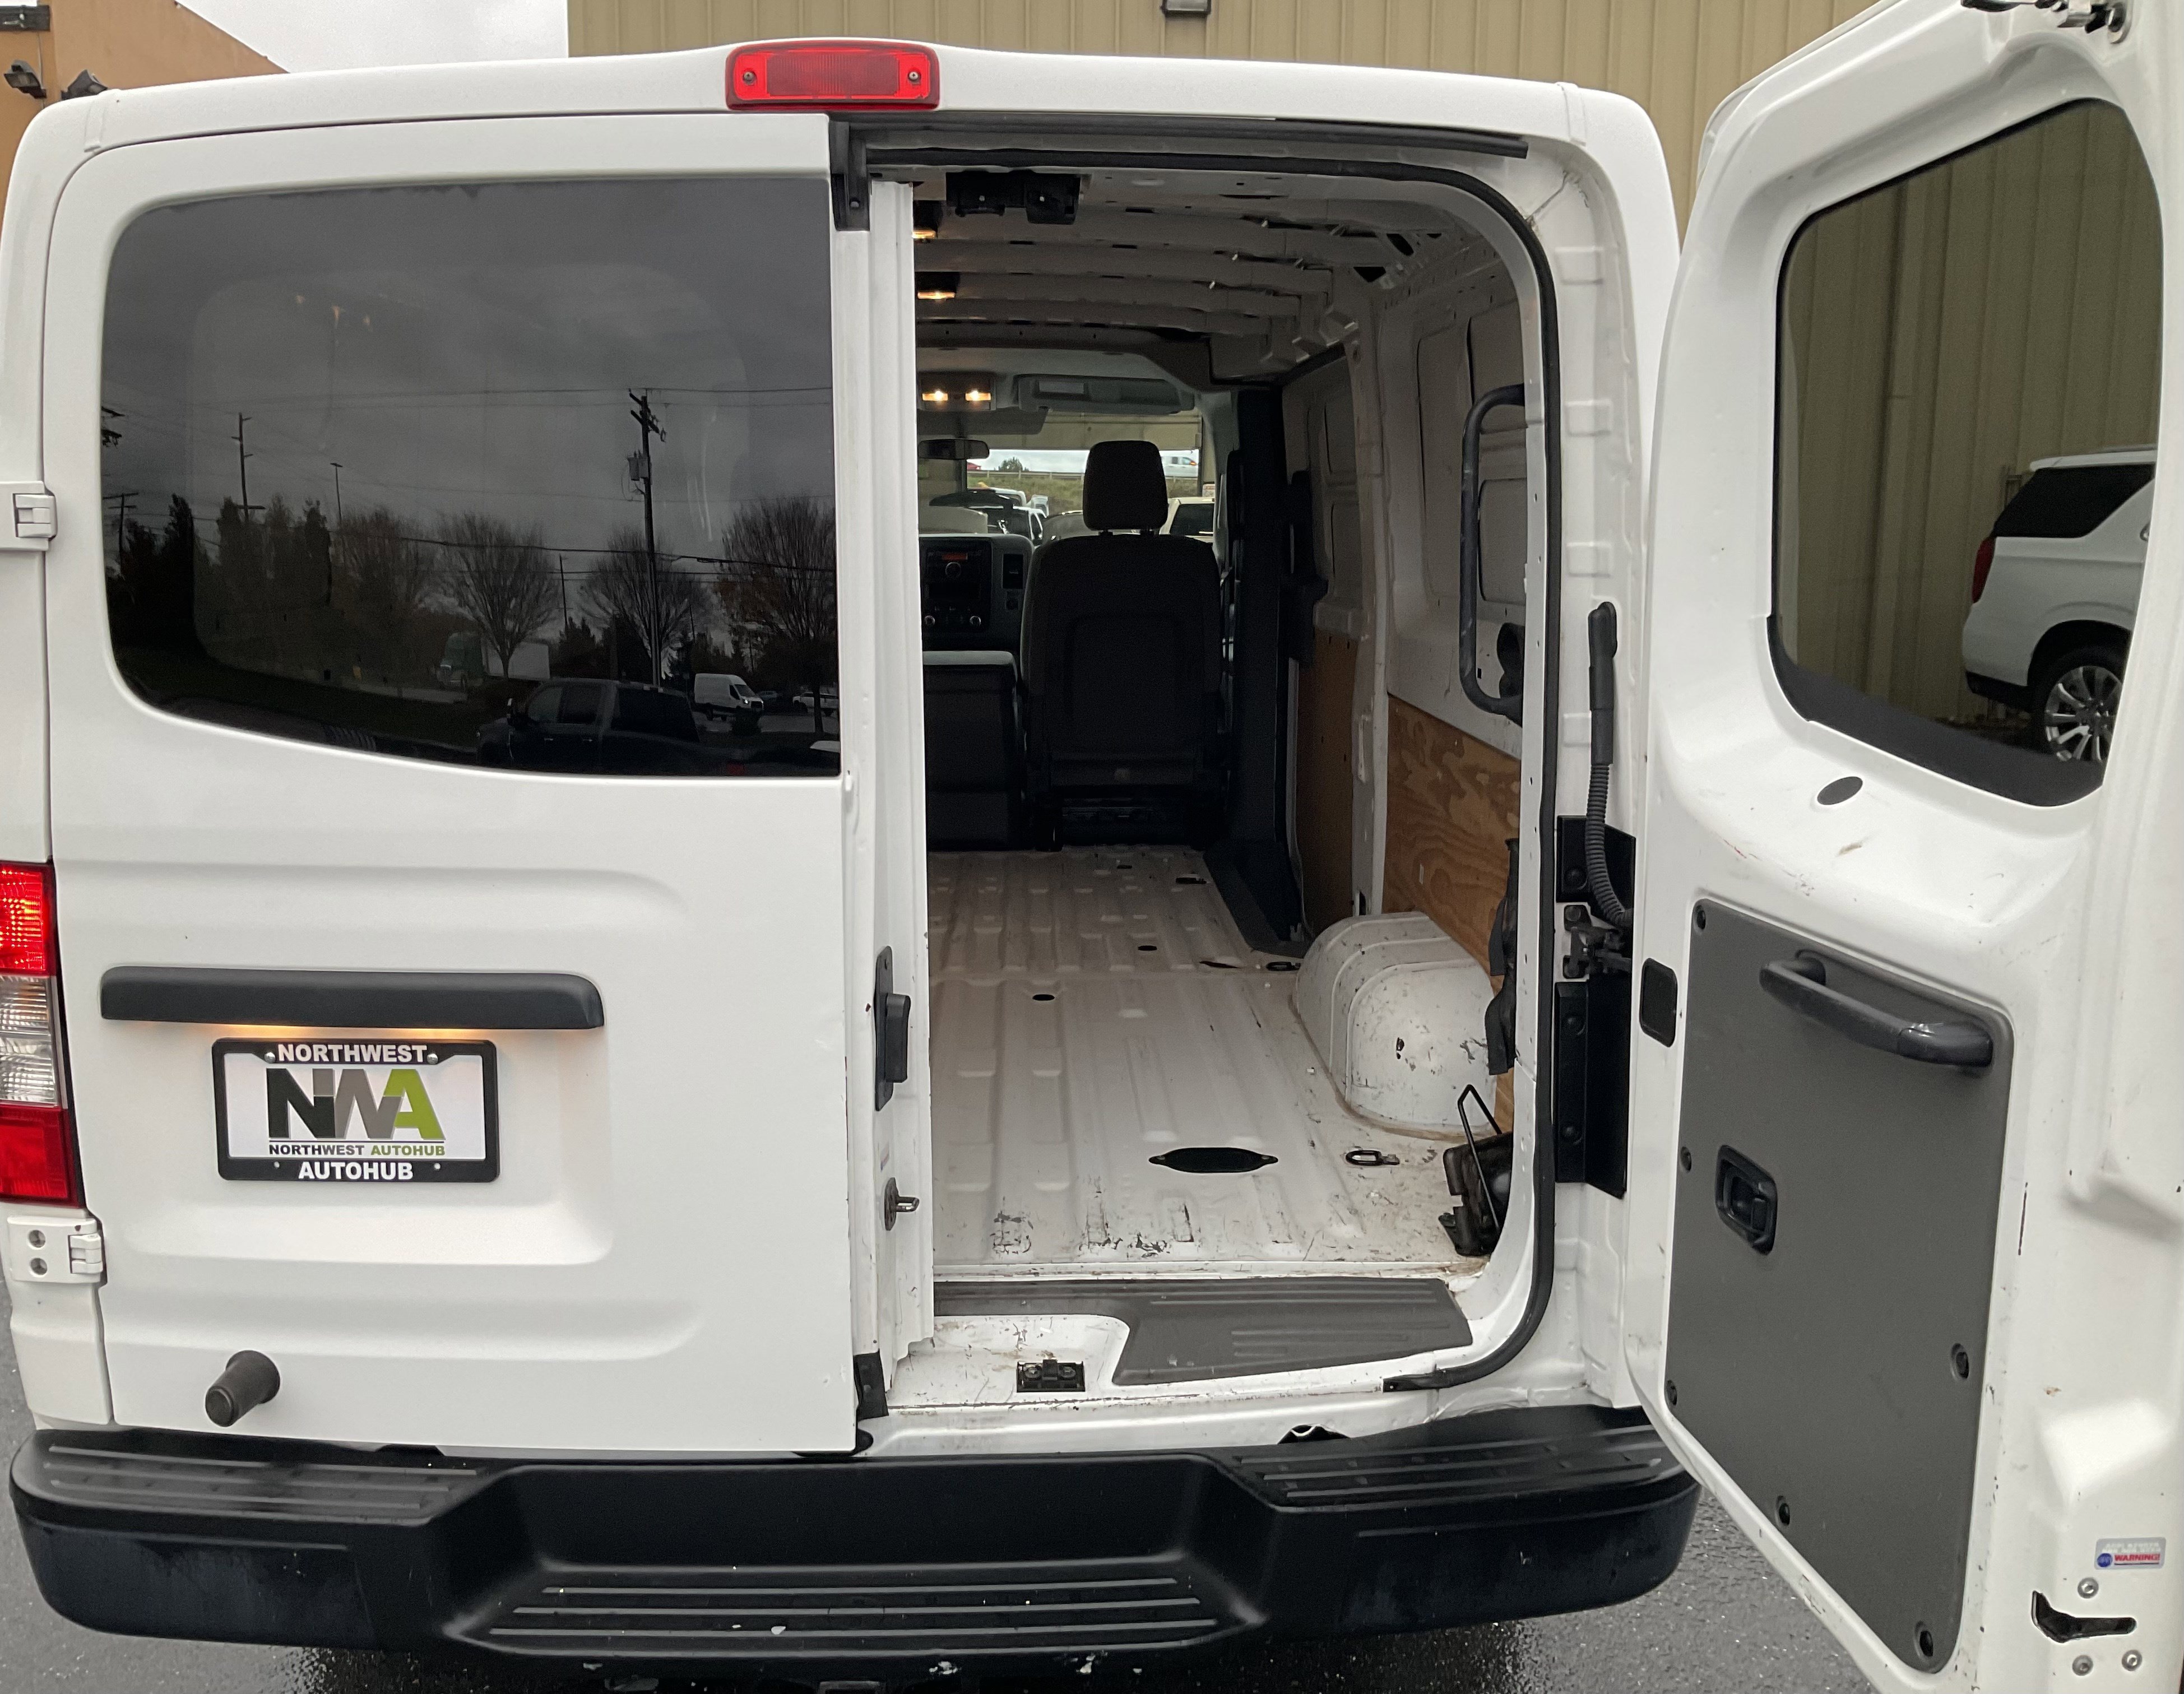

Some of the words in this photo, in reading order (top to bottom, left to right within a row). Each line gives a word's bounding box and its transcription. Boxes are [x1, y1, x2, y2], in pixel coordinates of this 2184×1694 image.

[278, 1044, 427, 1062] NORTHWEST
[269, 1144, 364, 1155] NORTHWEST
[370, 1145, 446, 1156] AUTOHUB
[298, 1161, 413, 1180] AUTOHUB
